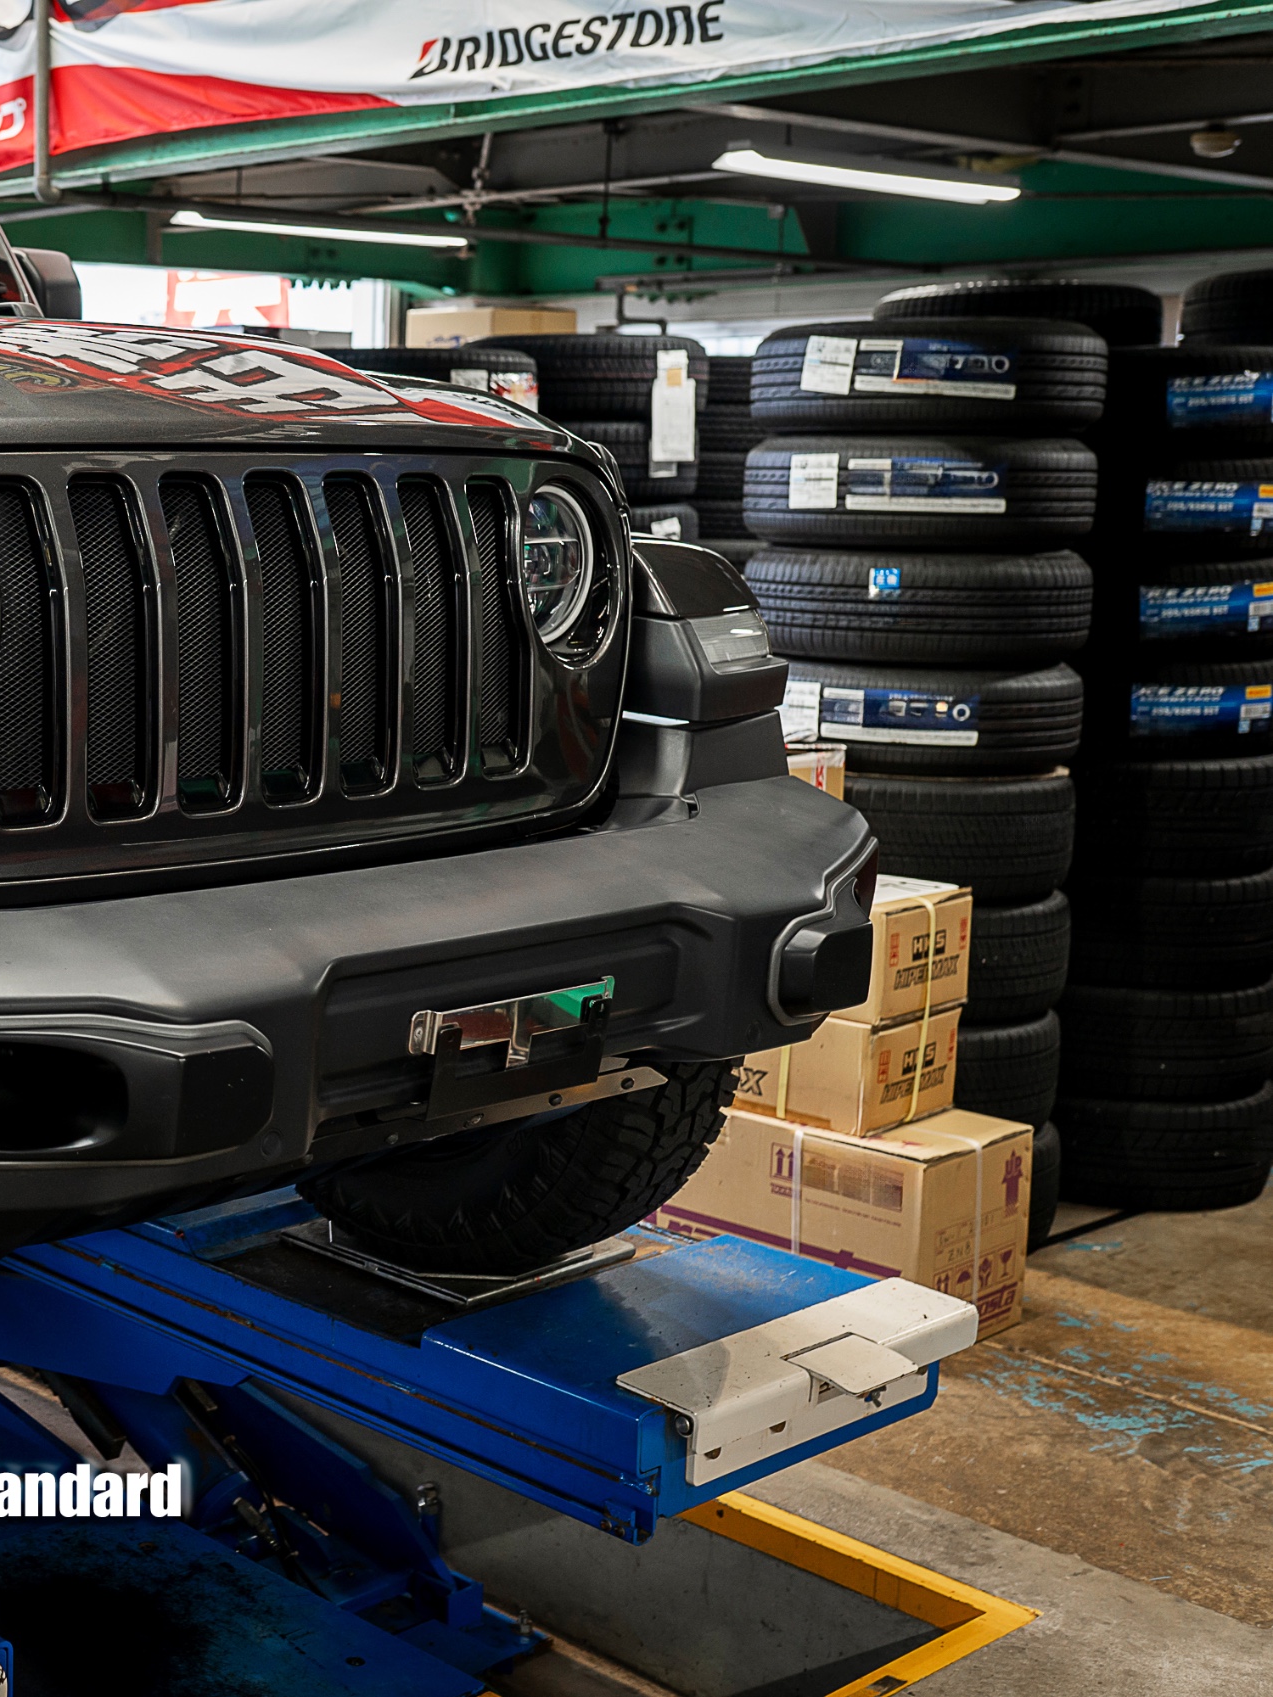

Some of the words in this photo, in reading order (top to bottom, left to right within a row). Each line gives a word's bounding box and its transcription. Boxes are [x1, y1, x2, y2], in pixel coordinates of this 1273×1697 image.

[409, 0, 725, 80] BRIDGESTONE
[894, 954, 960, 991] HIPEMAX
[903, 1042, 937, 1070] HS
